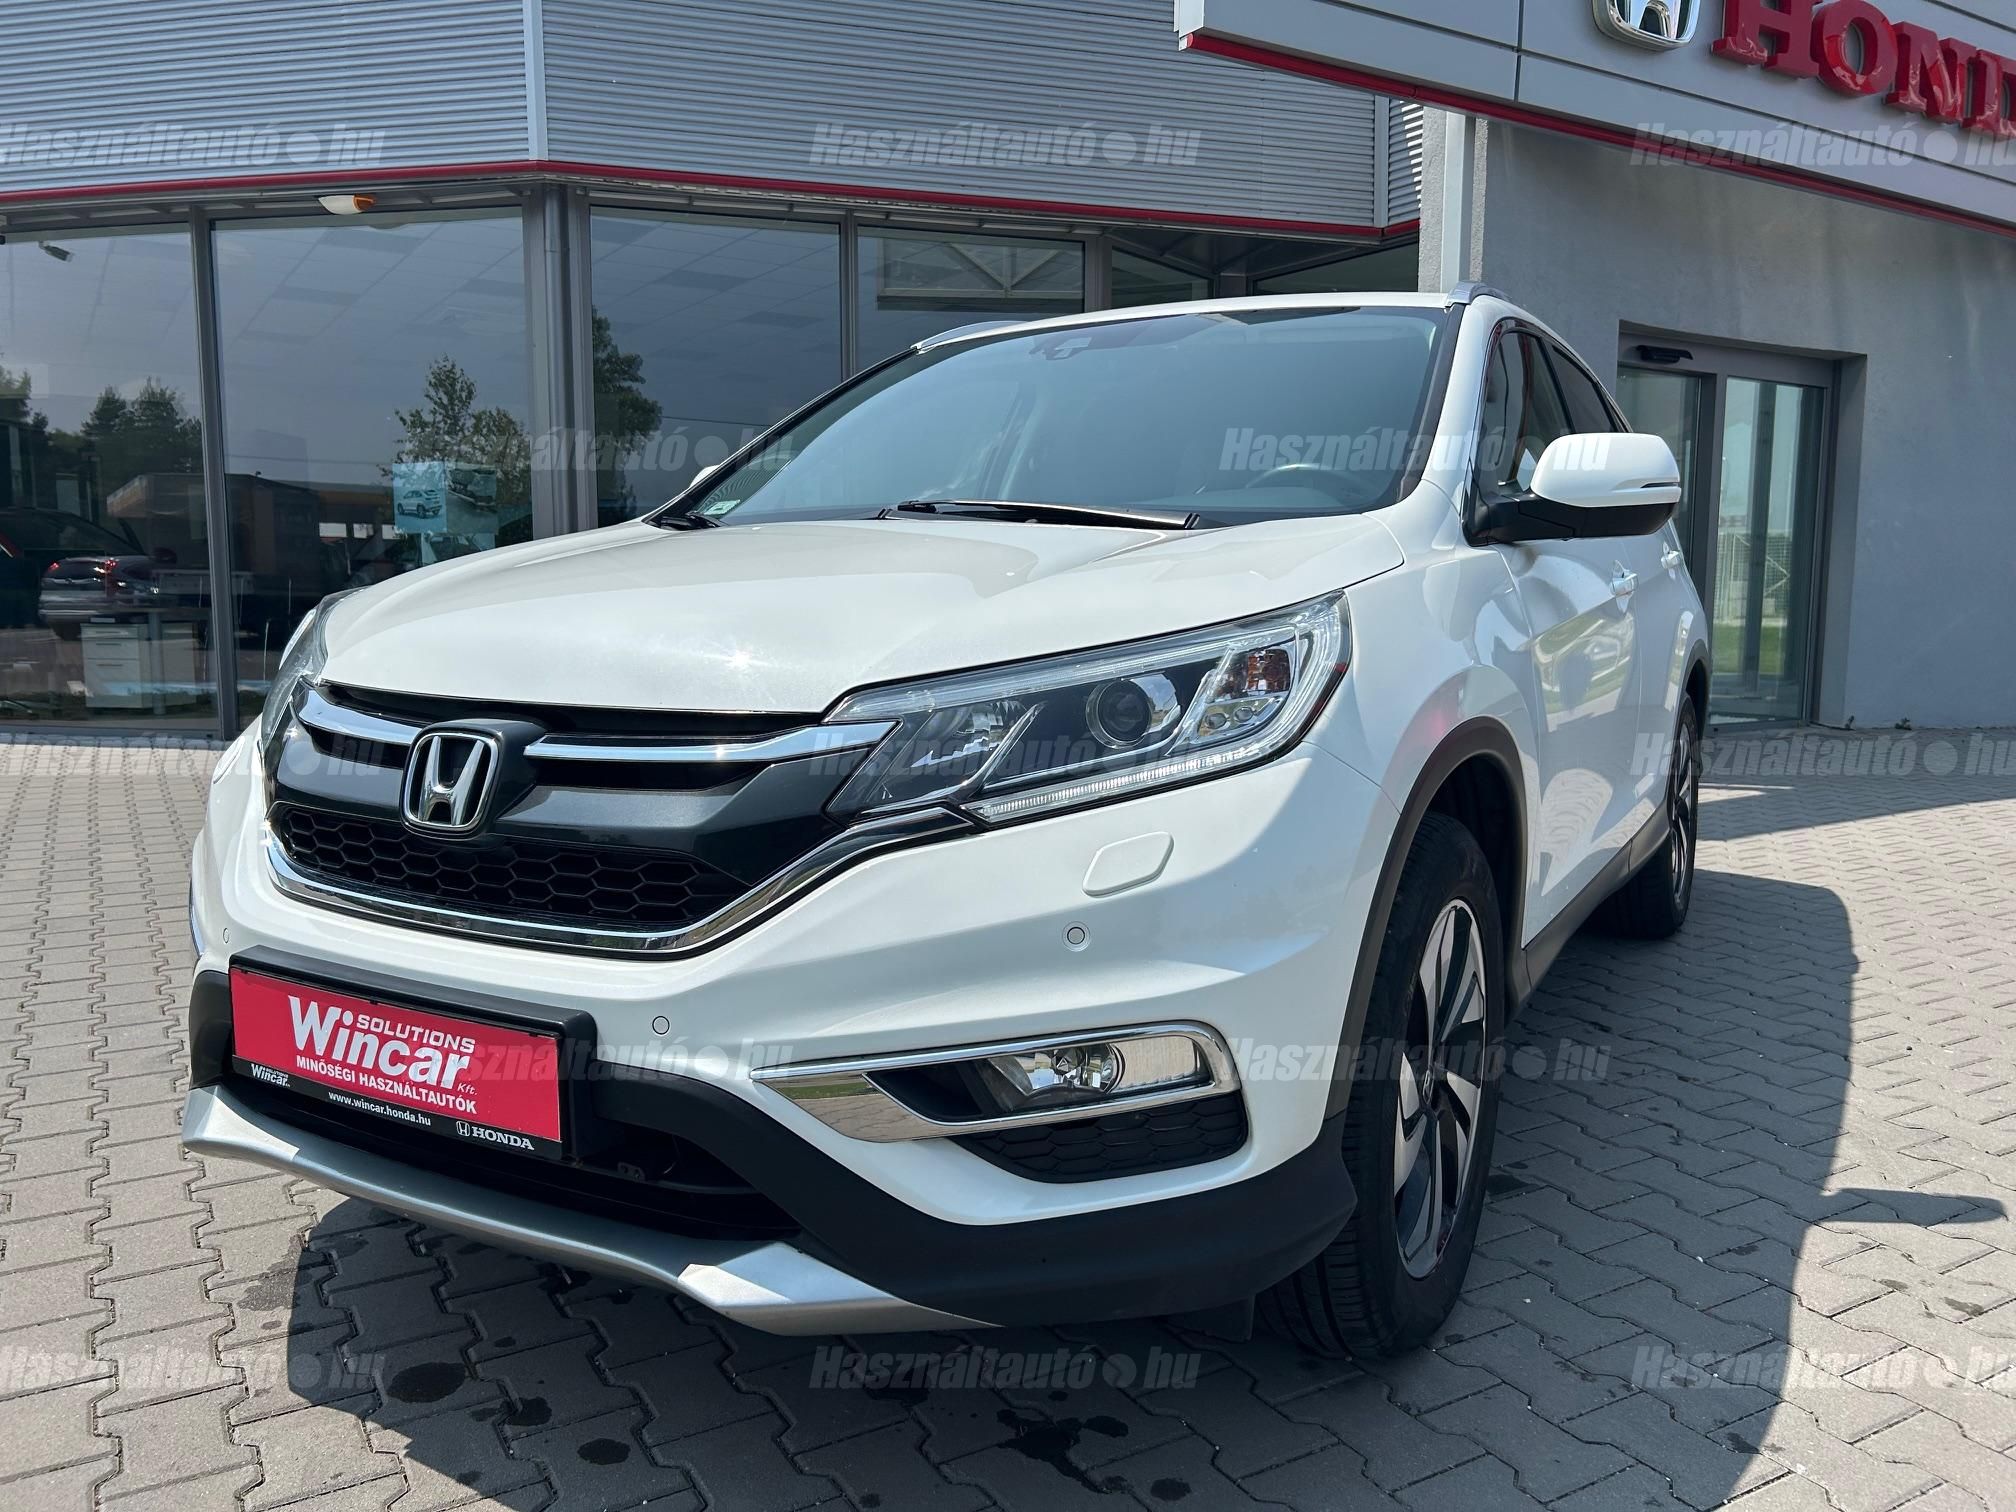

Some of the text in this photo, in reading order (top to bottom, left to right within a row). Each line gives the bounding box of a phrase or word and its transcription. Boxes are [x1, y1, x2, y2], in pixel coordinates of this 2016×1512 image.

[288, 995, 478, 1096] Wincar Kft.
[356, 1013, 476, 1054] SOLUTIONS
[251, 1063, 288, 1087] Wincar
[359, 1072, 478, 1115] HASZNÁLTAUTÓK
[328, 1091, 431, 1126] www.wincar.honda.hu
[471, 1126, 535, 1151] HONDA
